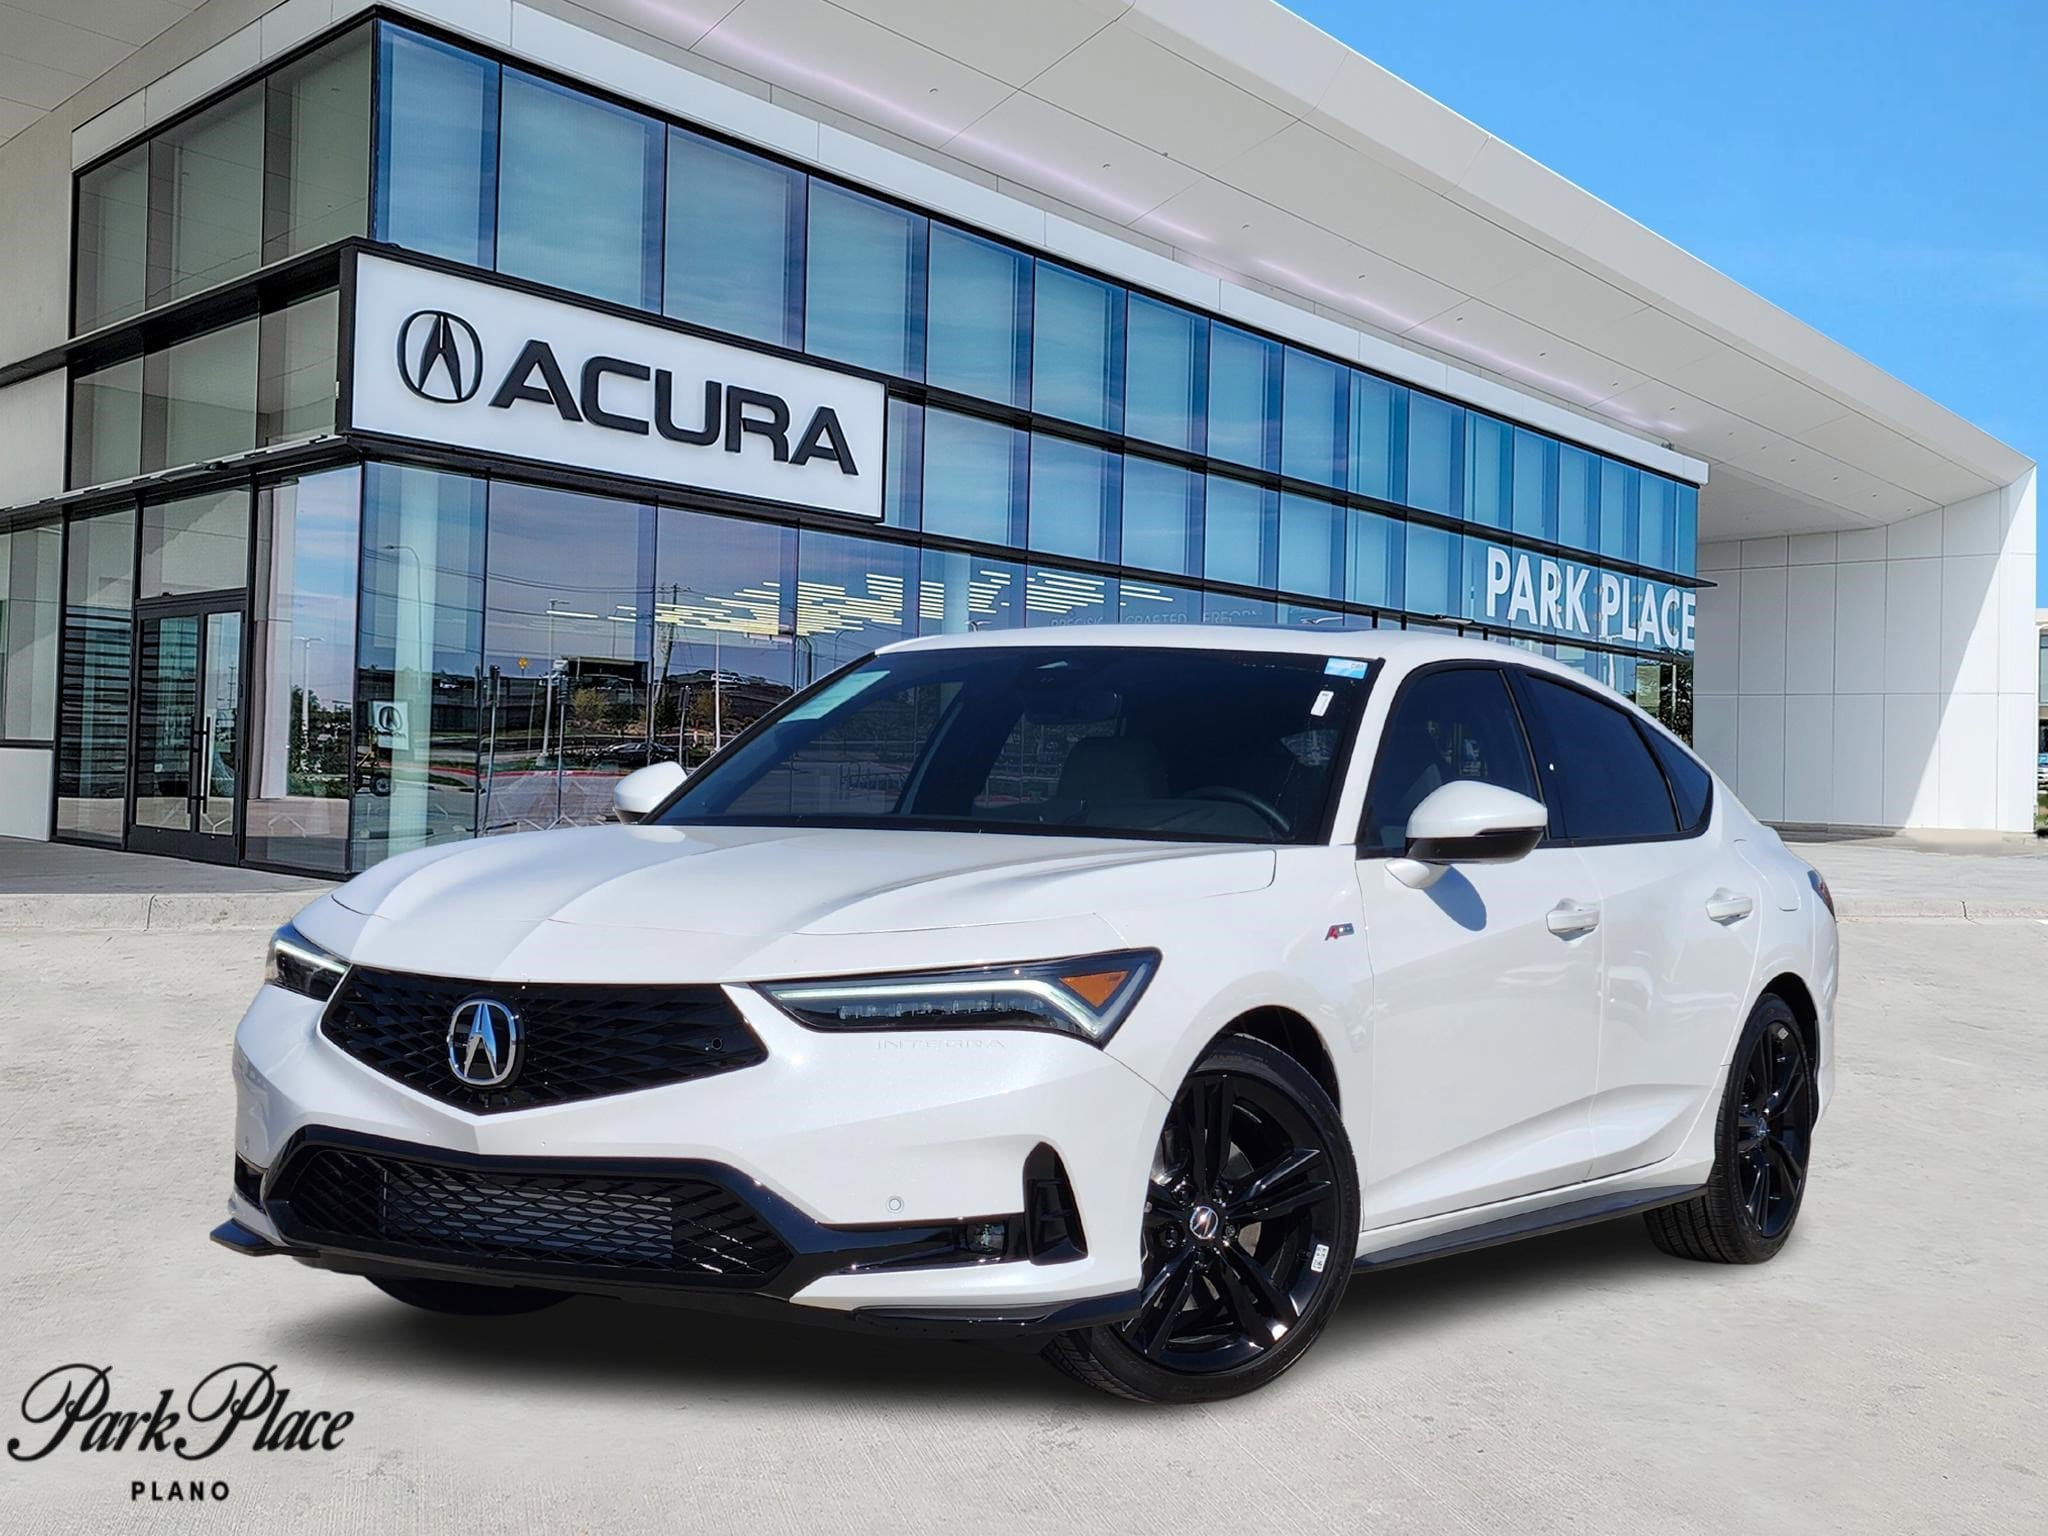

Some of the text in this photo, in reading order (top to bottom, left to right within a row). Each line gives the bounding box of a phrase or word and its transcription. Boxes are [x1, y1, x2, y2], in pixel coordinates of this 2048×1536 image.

[487, 338, 860, 477] ACURA
[1486, 546, 1696, 650] PARK PLACE
[876, 1038, 1008, 1049] INTEGRA
